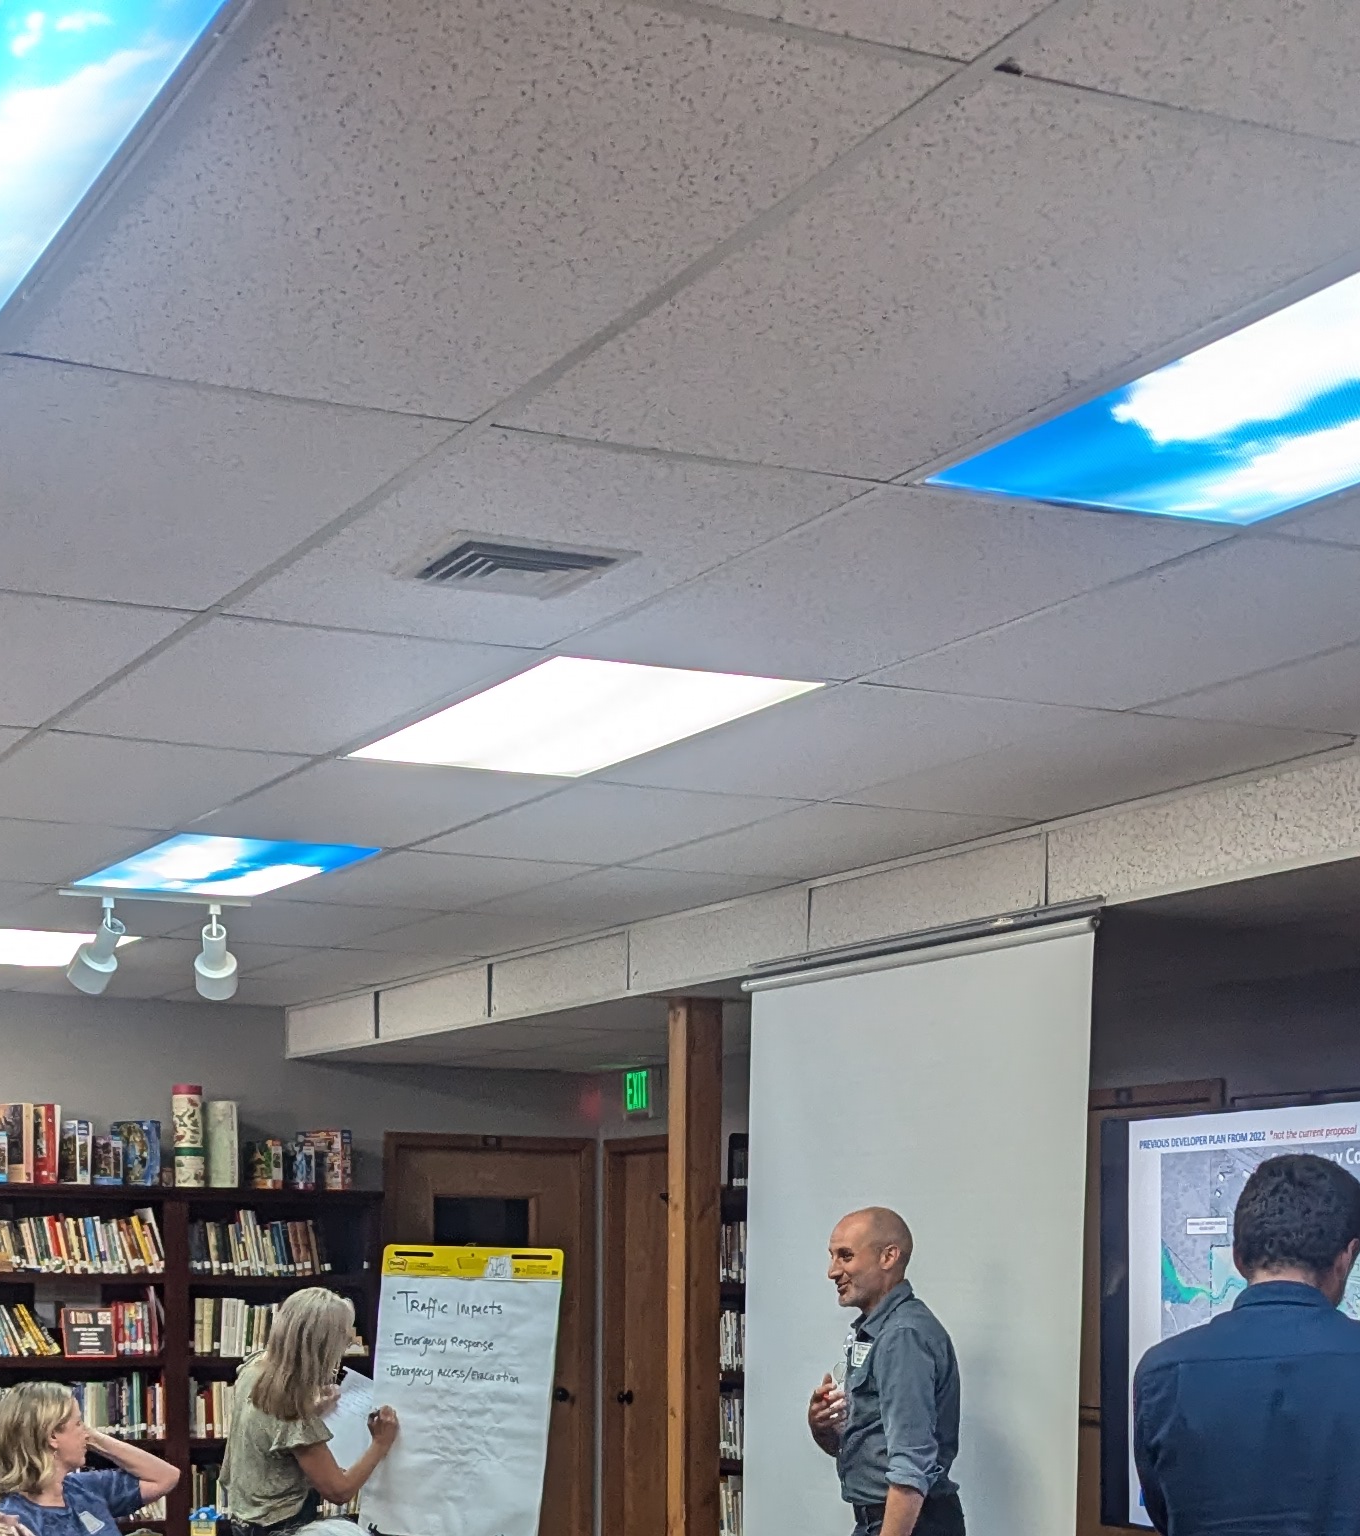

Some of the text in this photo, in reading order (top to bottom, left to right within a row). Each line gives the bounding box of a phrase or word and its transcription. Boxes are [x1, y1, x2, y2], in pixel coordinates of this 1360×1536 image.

[626, 1070, 647, 1110] EXIT
[1139, 1138, 1170, 1149] PREVIOUS
[1170, 1135, 1208, 1147] DEVELOPER
[1208, 1133, 1227, 1144] PLAN
[1227, 1132, 1248, 1143] FROM
[1249, 1131, 1266, 1142] 2022
[1286, 1128, 1298, 1139] the
[1298, 1127, 1324, 1138] current
[1324, 1124, 1358, 1138] proposal
[394, 1332, 494, 1356] Emergency Response
[390, 1365, 434, 1386] Emergency
